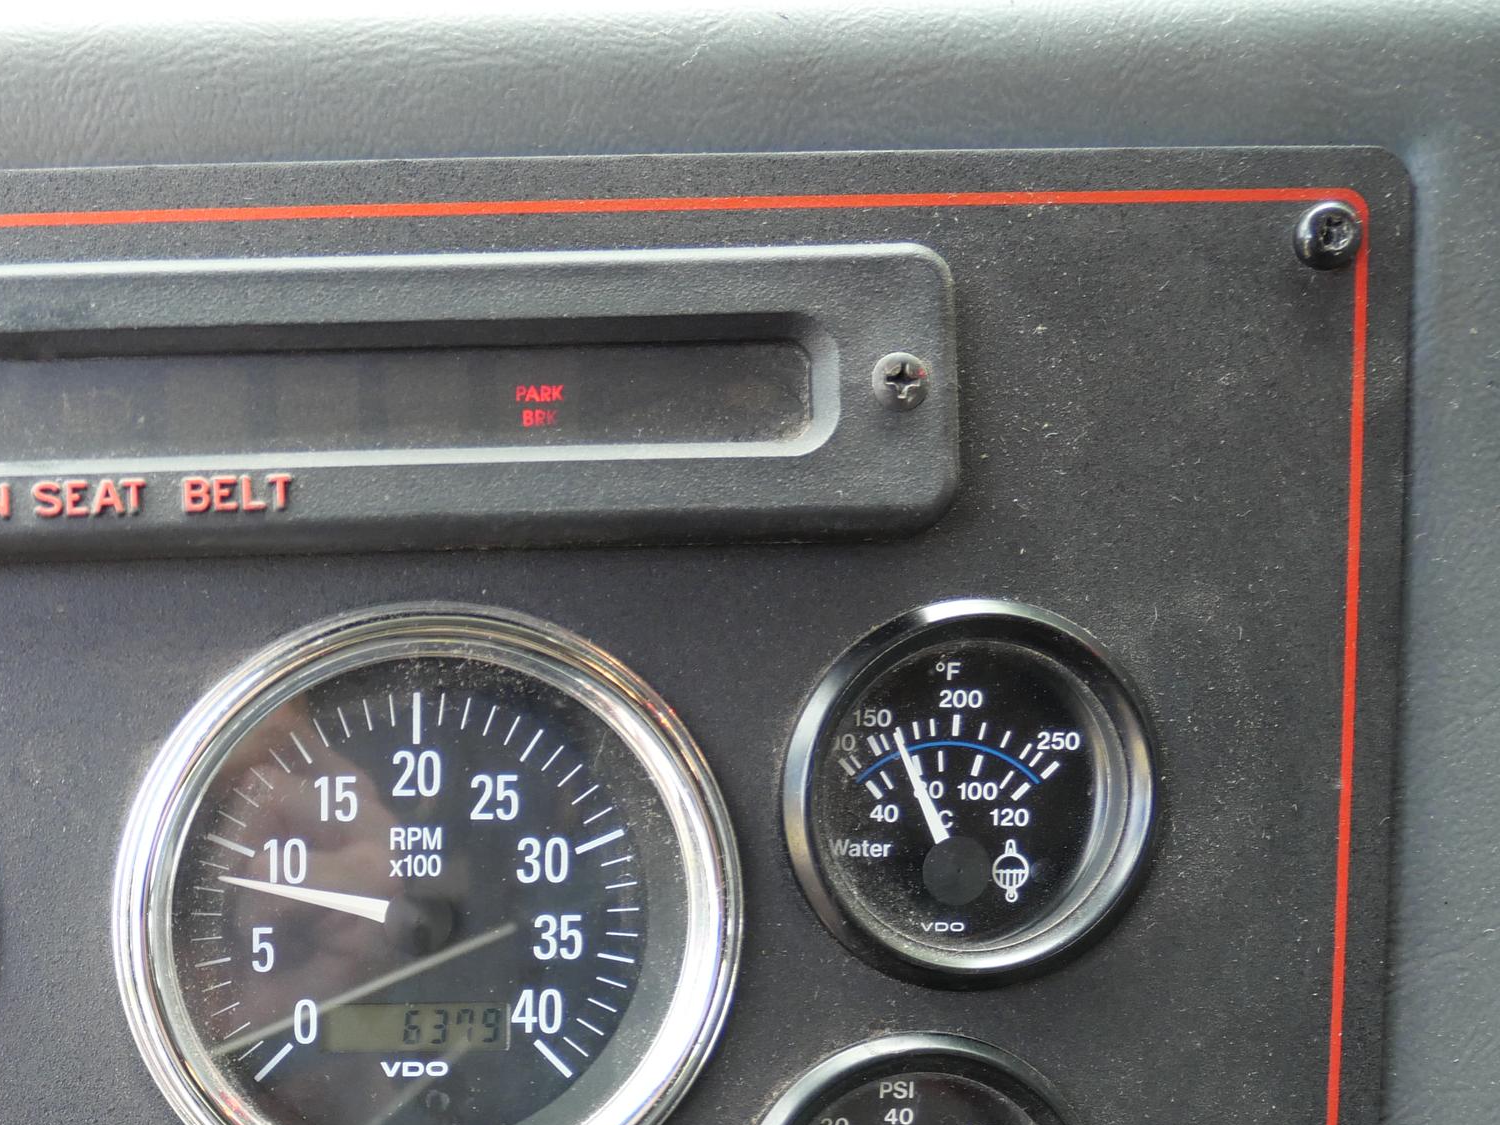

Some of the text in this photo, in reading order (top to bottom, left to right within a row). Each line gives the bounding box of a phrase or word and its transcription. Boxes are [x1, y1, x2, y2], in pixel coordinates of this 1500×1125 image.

[516, 384, 564, 402] PARK
[522, 409, 559, 427] BRK
[30, 477, 146, 518] SEAT
[182, 472, 292, 514] BELT
[936, 662, 961, 680] °F
[939, 690, 983, 708] 200
[853, 709, 892, 727] 150
[1037, 732, 1080, 751] 250
[392, 750, 442, 798] 20
[314, 776, 358, 822] 15
[470, 775, 519, 820] 25
[957, 782, 998, 801] 100
[870, 804, 899, 822] 40
[989, 809, 1029, 827] 120
[389, 827, 443, 851] RPM
[829, 839, 891, 857] Water
[263, 839, 307, 883] 10
[389, 855, 442, 877] x100
[517, 838, 569, 883] 30
[920, 922, 965, 932] VDO
[533, 915, 583, 960] 35
[252, 927, 274, 973] 5
[294, 999, 318, 1044] 0
[511, 990, 562, 1034] 40
[380, 1062, 448, 1077] VDO
[879, 1081, 914, 1099] PSI
[884, 1108, 914, 1125] 40
